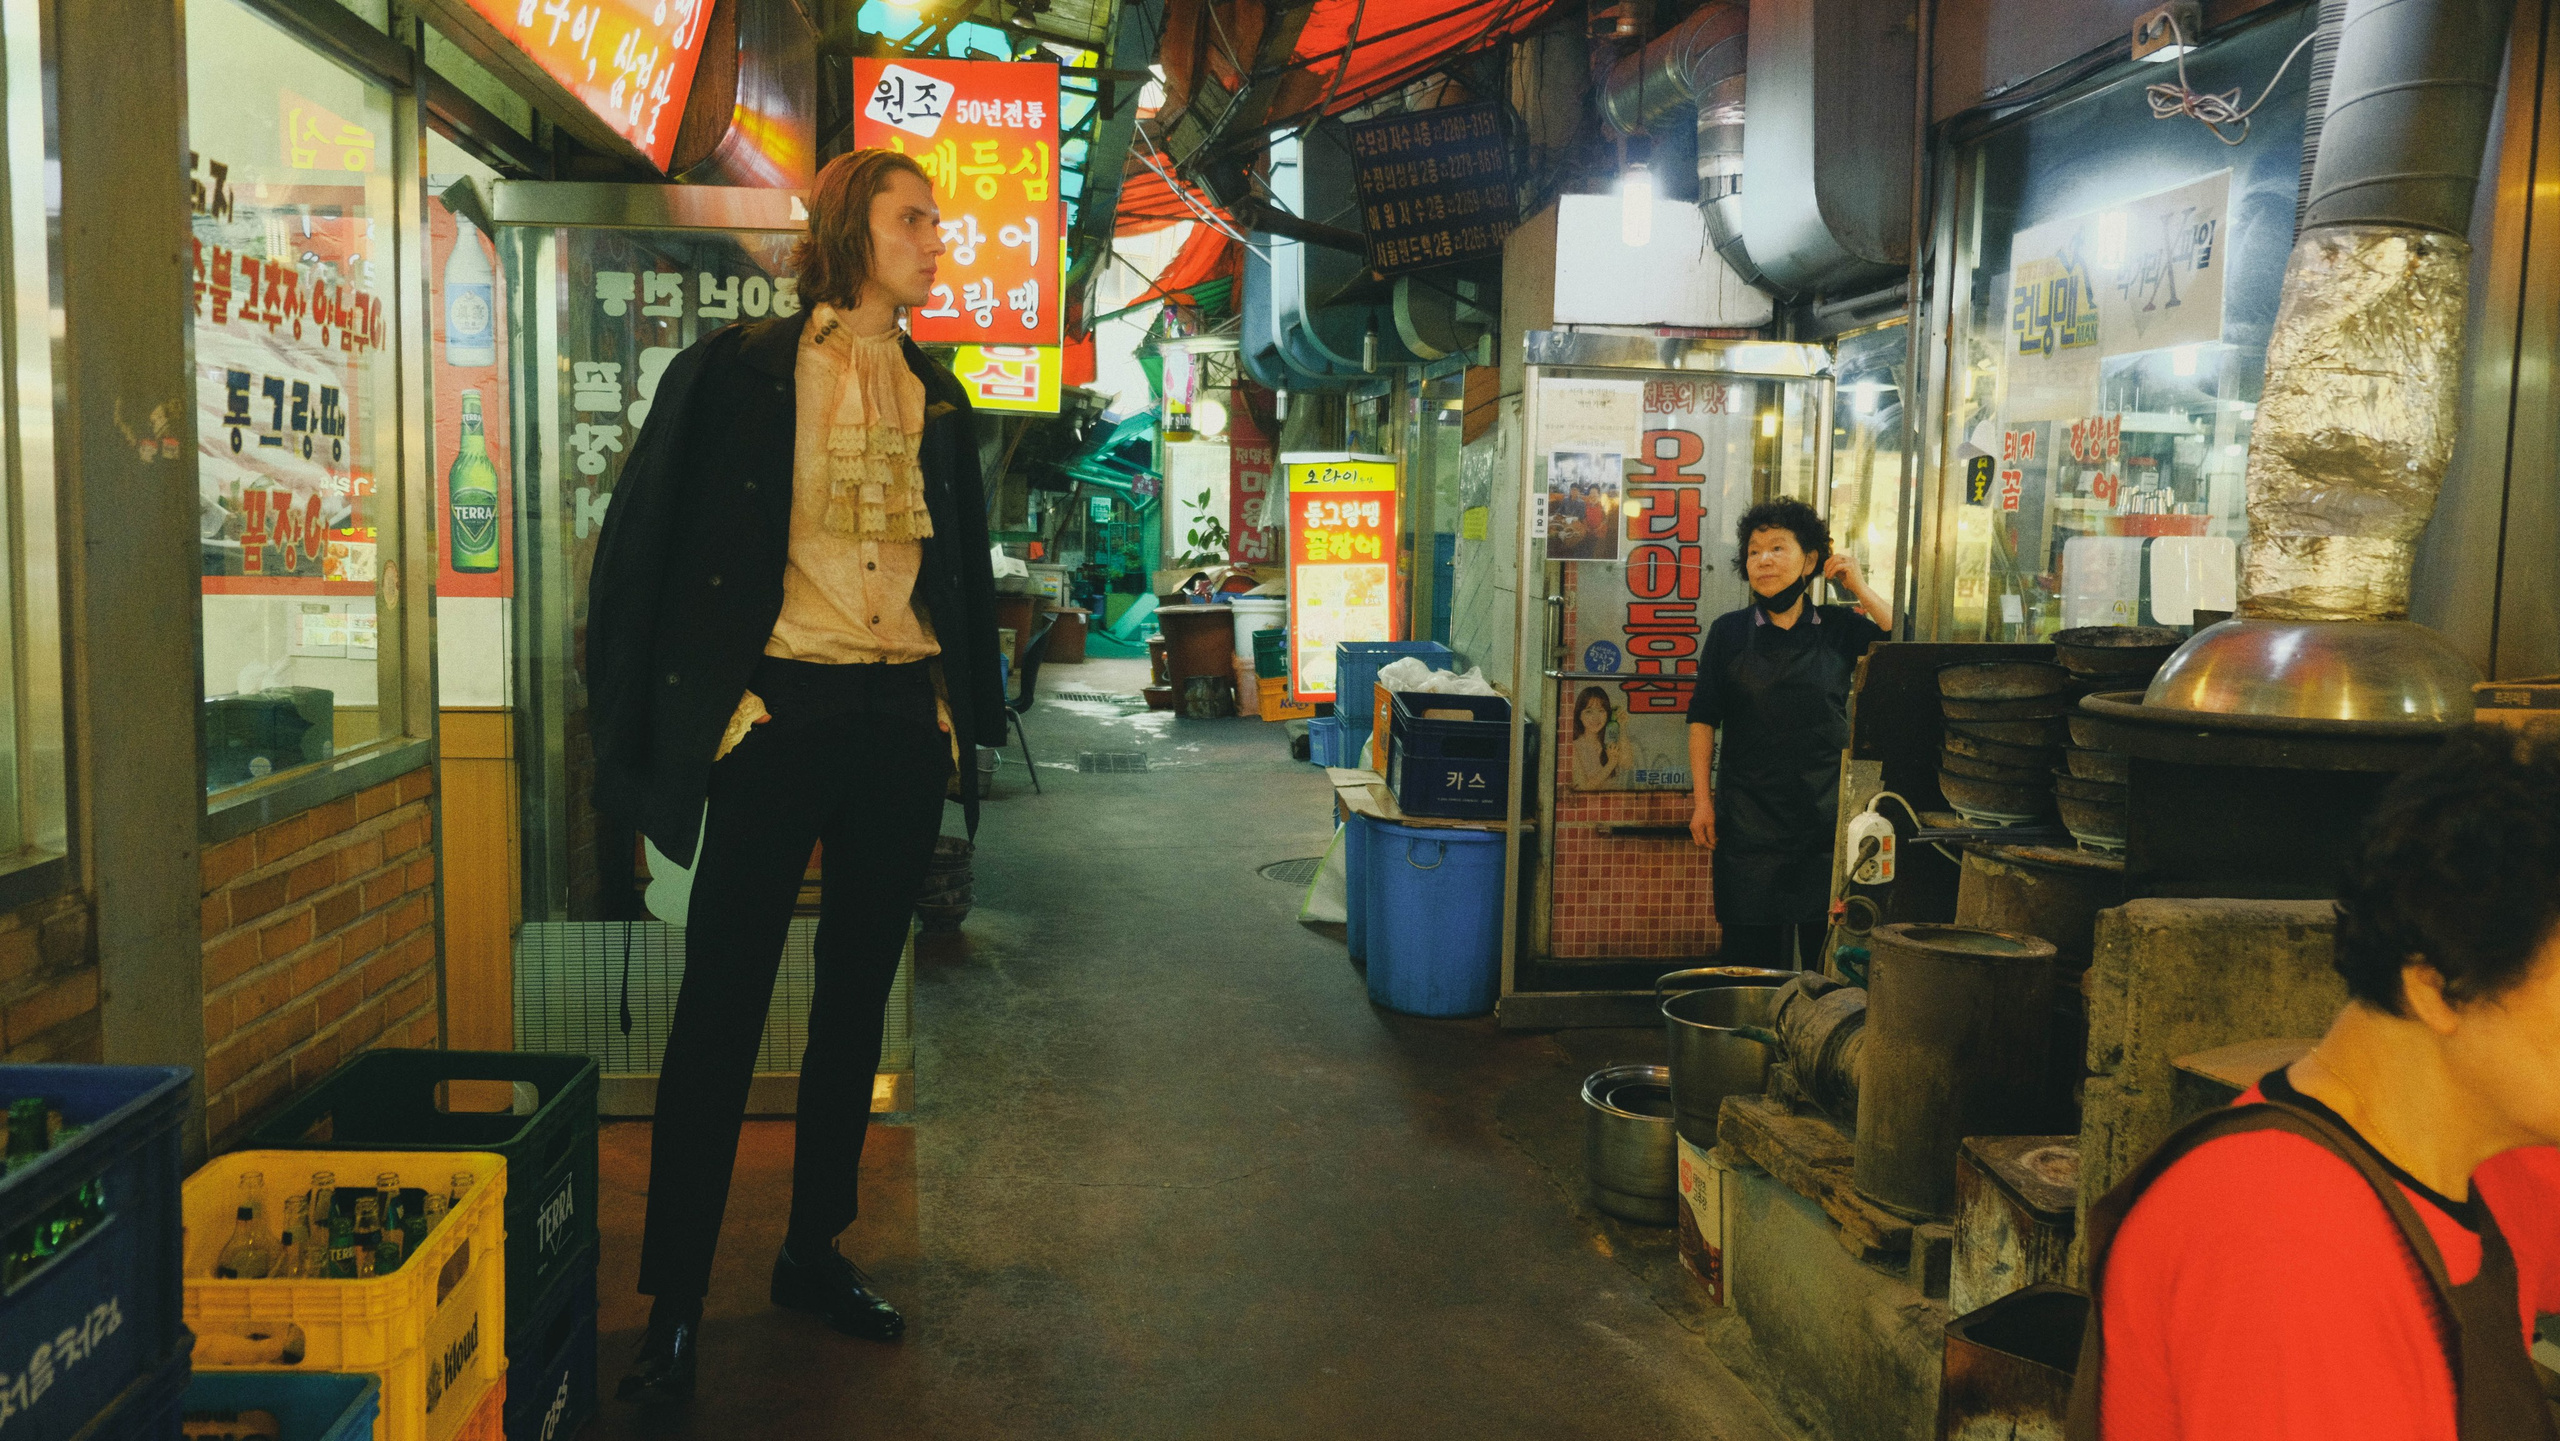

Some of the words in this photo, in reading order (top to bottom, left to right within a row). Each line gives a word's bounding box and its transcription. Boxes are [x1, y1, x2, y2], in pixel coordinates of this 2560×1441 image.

[874, 76, 942, 125] 원조
[956, 99, 1046, 129] 50년전통
[866, 136, 1050, 202] 매등심
[1419, 159, 1438, 182] 2층
[1426, 196, 1445, 218] 2층
[1433, 232, 1452, 255] 2층
[2013, 274, 2078, 355] 런닝맨
[965, 346, 1040, 402] 심
[1644, 380, 1695, 414] 전통의
[223, 368, 346, 463] 동그랑땡
[2003, 430, 2036, 464] 돼지
[1303, 470, 1358, 486] 오라이
[454, 506, 494, 520] TERRA
[1237, 470, 1270, 559] 미용실
[1303, 500, 1381, 528] 동그랑땡
[240, 489, 331, 574] 꼼장어
[1303, 530, 1382, 560] 꼼장어
[1445, 771, 1486, 791] 카스
[537, 1181, 574, 1253] TERRA
